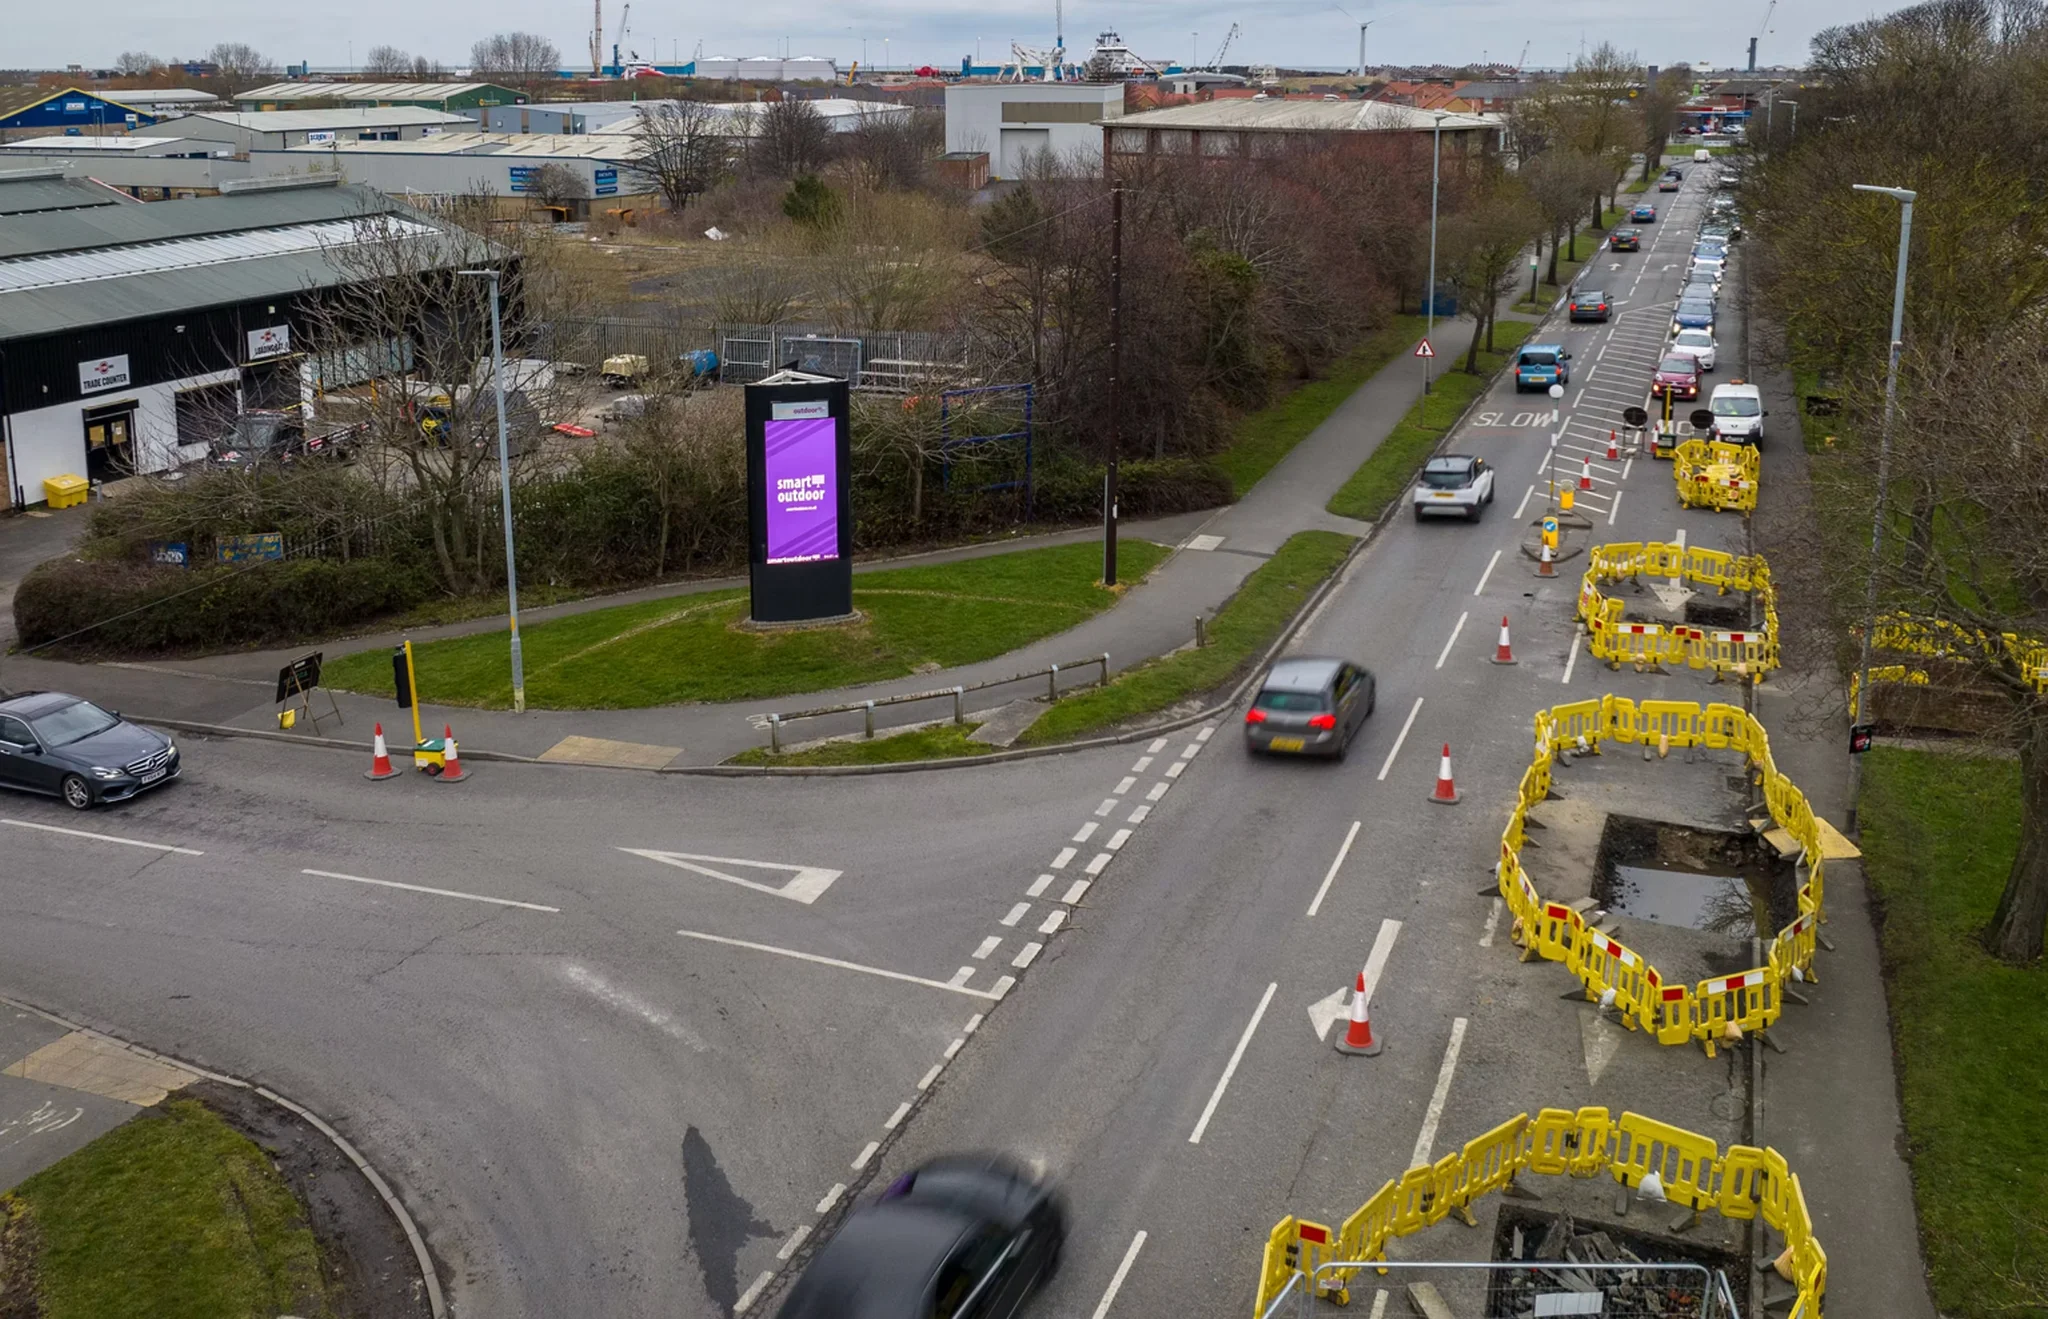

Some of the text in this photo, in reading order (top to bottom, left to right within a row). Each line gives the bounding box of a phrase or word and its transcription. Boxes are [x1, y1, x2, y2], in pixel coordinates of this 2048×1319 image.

[83, 373, 127, 389] TRADE COUNTER
[1473, 412, 1554, 428] SLOW
[777, 475, 812, 489] smart
[777, 488, 825, 503] outdoor
